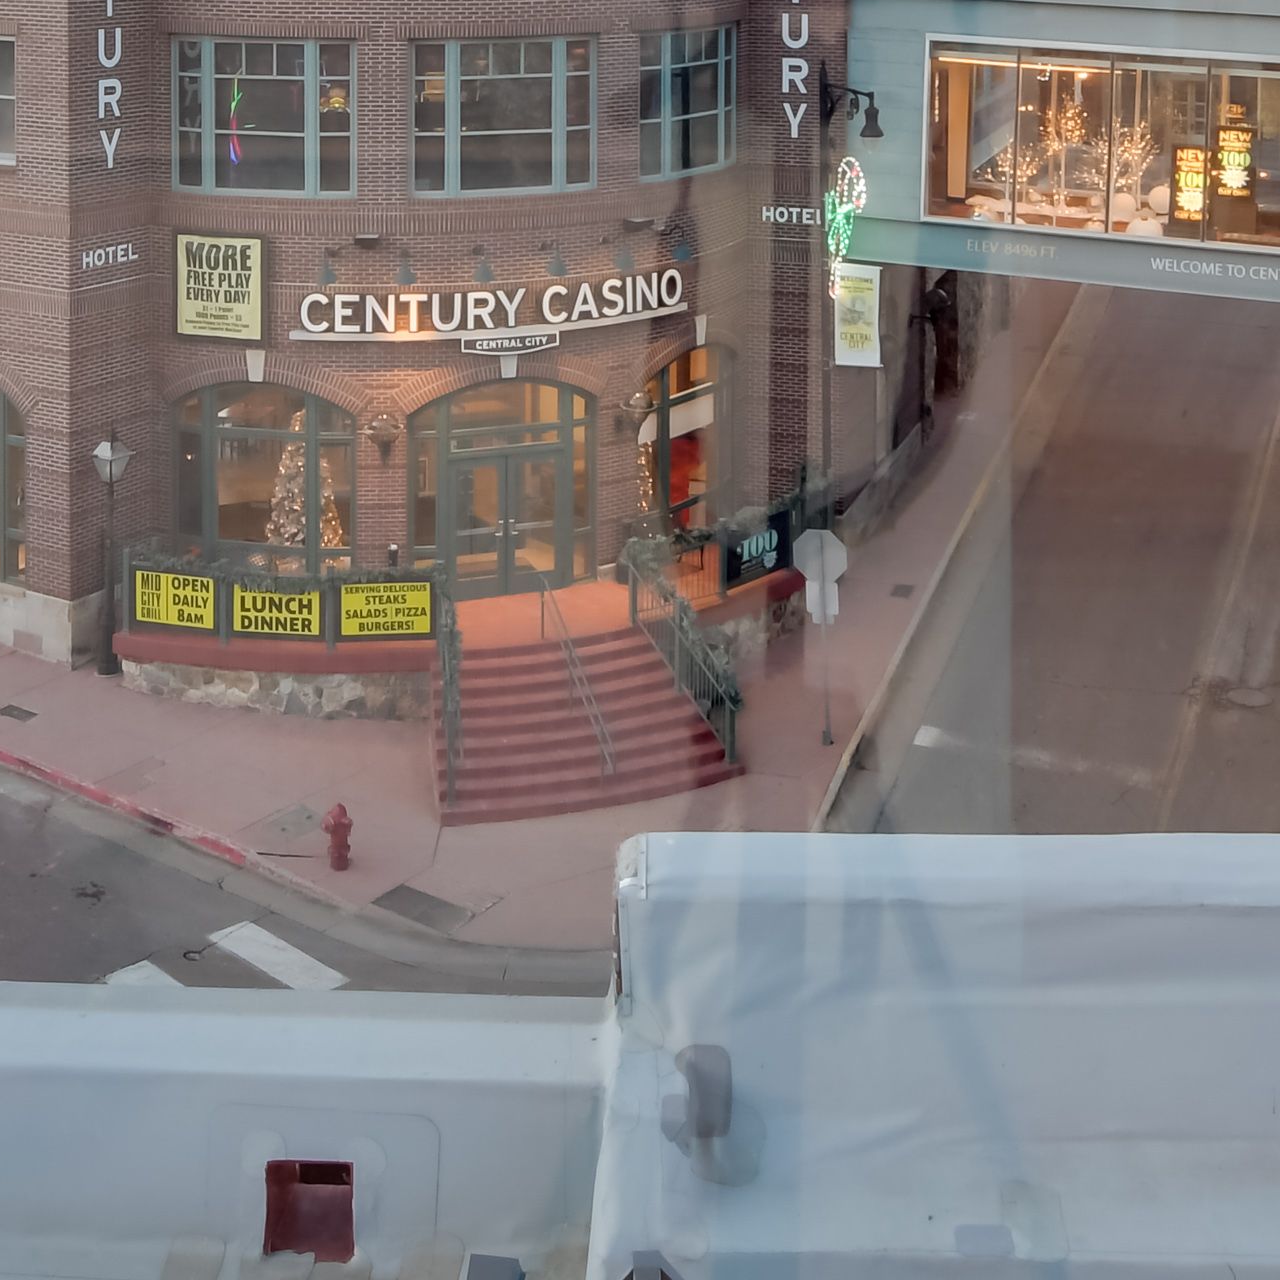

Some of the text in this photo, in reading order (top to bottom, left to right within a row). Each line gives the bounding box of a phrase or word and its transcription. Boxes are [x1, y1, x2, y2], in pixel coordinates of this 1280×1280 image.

[1219, 130, 1252, 142] NEW
[82, 242, 139, 270] HOTEL
[185, 241, 252, 271] MORE
[967, 239, 999, 254] ELEV
[1004, 243, 1037, 257] 8496
[1150, 257, 1224, 277] WELCOME
[1226, 263, 1245, 278] TO
[186, 269, 251, 288] FREE PLAY
[186, 287, 250, 305] EVERY DAY!
[300, 268, 683, 333] CENTURY CASINO
[476, 336, 548, 349] CENTRAL CITY
[840, 332, 872, 341] CENTRAL
[848, 340, 865, 349] CITY
[141, 573, 161, 591] MID
[172, 577, 209, 593] OPEN
[344, 584, 427, 594] SERVING DELICIOUS
[141, 591, 160, 607] CITY
[173, 594, 209, 609] DAILY
[240, 595, 312, 615] LUNCH
[365, 594, 407, 605] STEAKS
[141, 607, 161, 620] GRILL
[177, 609, 204, 624] 8AM
[345, 607, 427, 619] SALADS PIZZA
[240, 615, 312, 632] DINNER
[359, 621, 414, 632] BURGERS!
